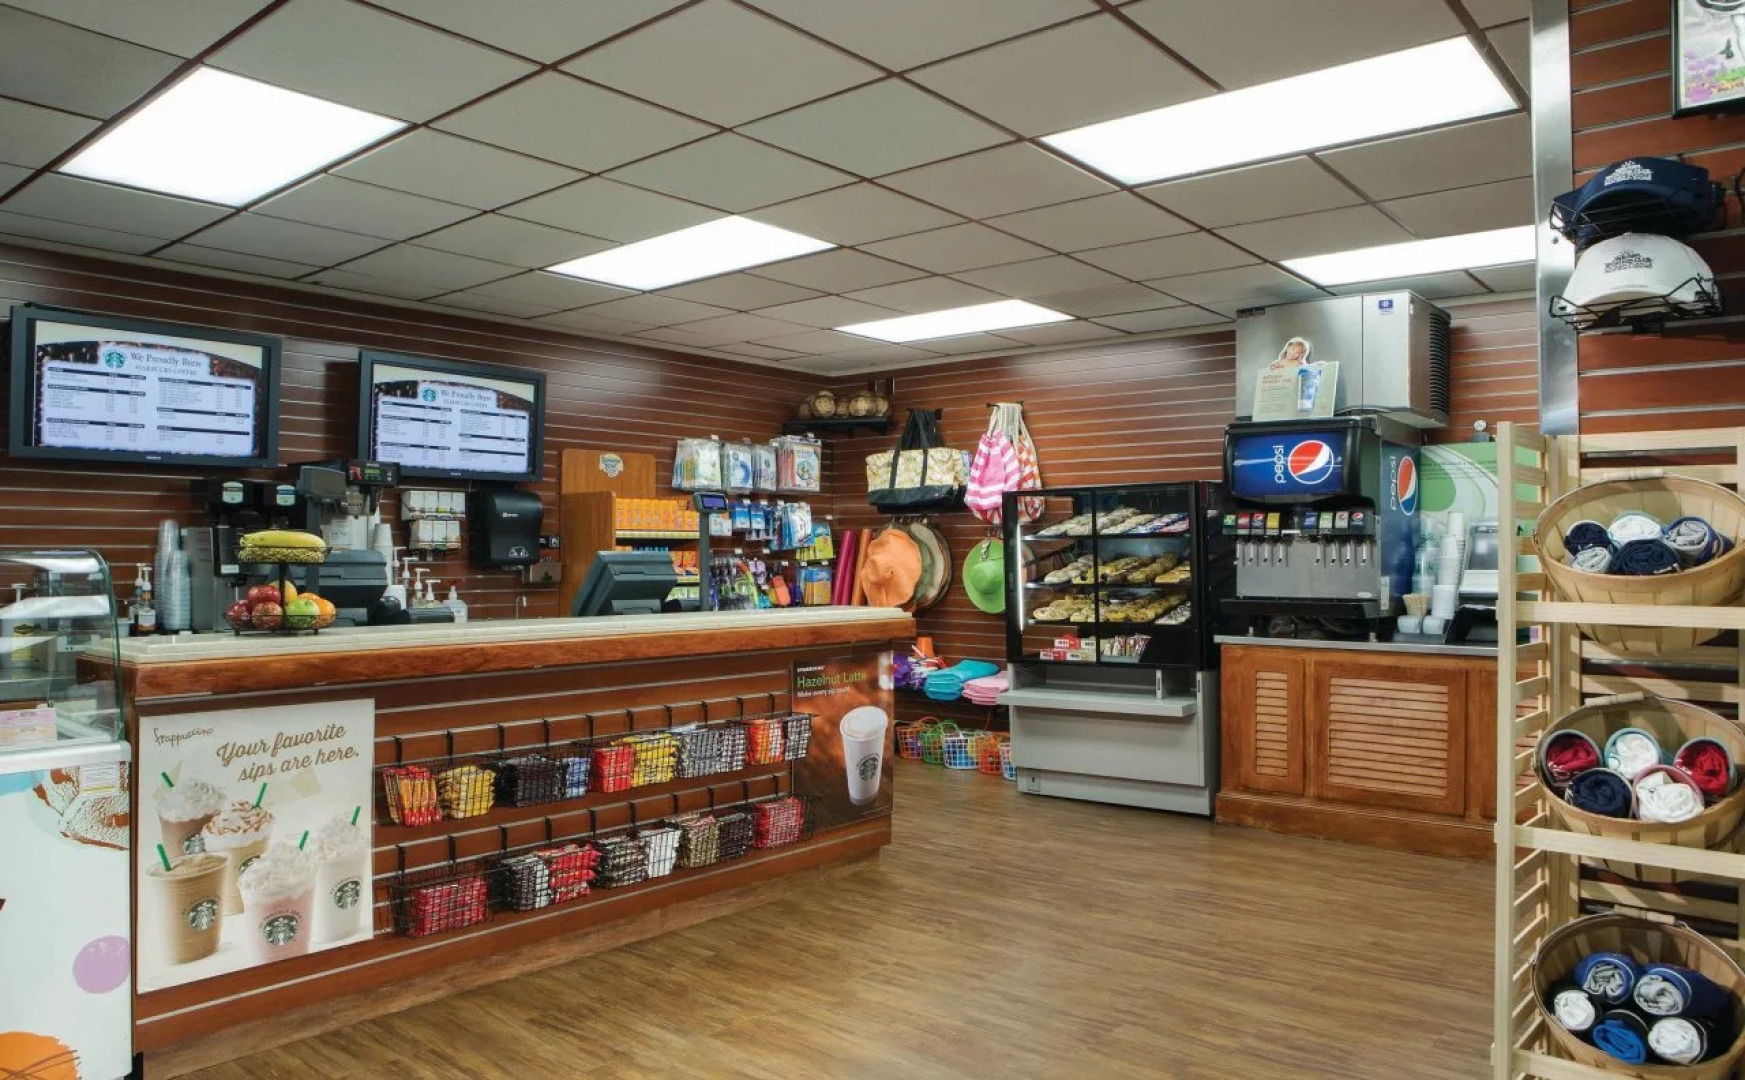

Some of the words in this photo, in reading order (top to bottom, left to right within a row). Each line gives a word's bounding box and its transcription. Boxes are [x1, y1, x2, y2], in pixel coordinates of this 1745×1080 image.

[130, 352, 144, 361] We
[146, 354, 179, 366] Proudly
[182, 358, 202, 368] Brew
[1272, 445, 1287, 485] pepsi
[797, 675, 840, 688] Hazelnut
[843, 671, 867, 683] Latte
[216, 740, 271, 766] Your
[271, 723, 348, 758] favorite
[238, 763, 276, 782] sips
[280, 754, 313, 773] are
[316, 745, 360, 765] here.
